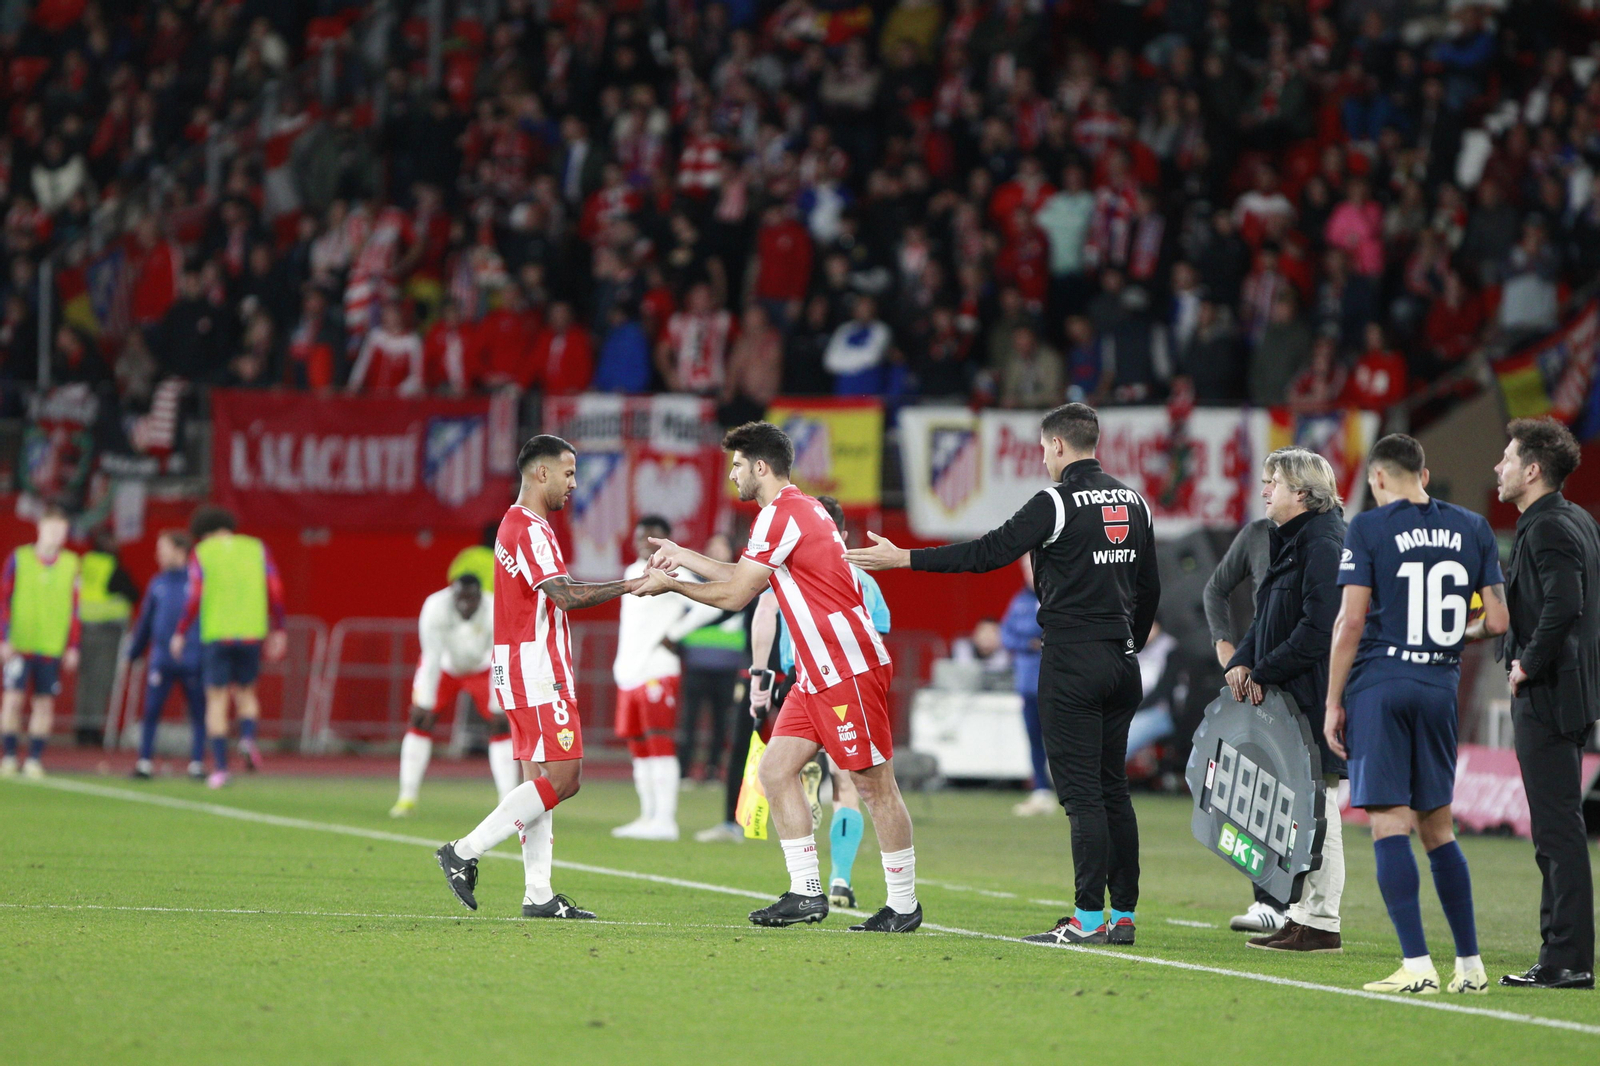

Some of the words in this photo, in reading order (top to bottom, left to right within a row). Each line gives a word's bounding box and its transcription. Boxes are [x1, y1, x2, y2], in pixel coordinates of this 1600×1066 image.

[1072, 489, 1140, 508] macron
[1395, 528, 1462, 553] MOLINA
[1396, 560, 1469, 647] 16
[552, 700, 570, 726] 8
[1256, 708, 1275, 724] BKT
[838, 730, 858, 742] KUDU
[1220, 828, 1264, 871] BKT
